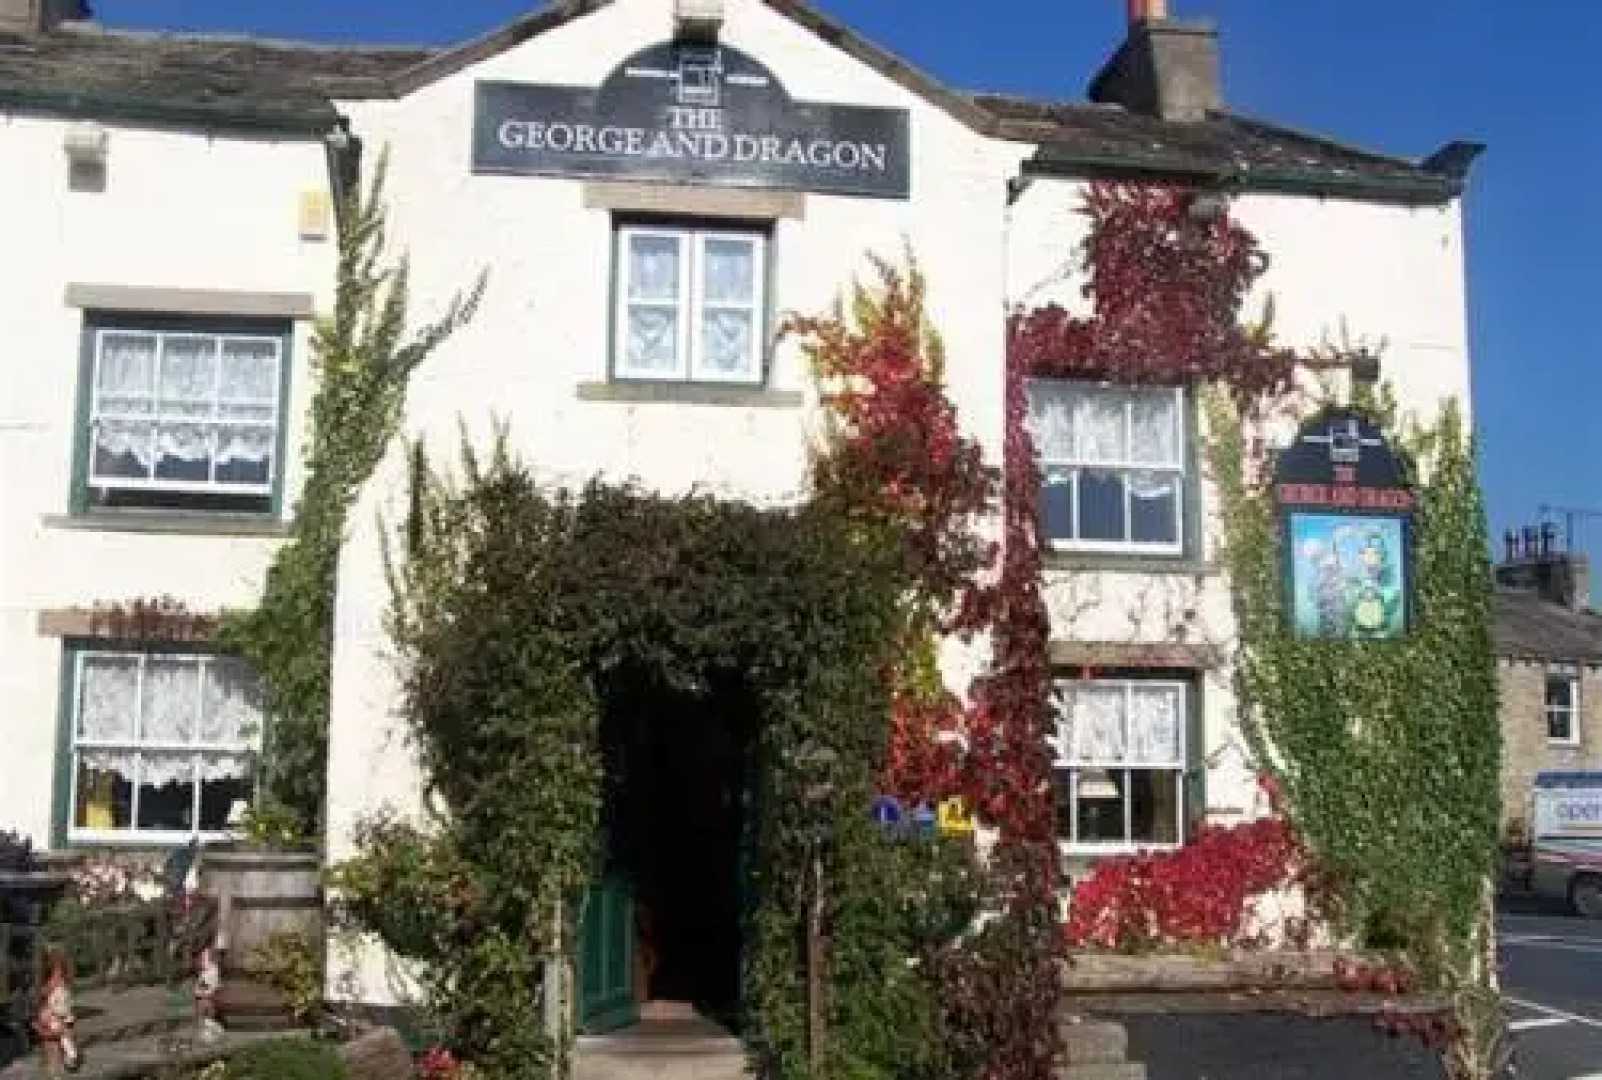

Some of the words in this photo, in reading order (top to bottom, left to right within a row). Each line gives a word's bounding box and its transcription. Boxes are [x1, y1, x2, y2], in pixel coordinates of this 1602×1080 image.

[669, 106, 719, 129] THE
[499, 121, 645, 155] GEORGE
[646, 131, 728, 160] AND
[733, 134, 885, 170] DRAGON
